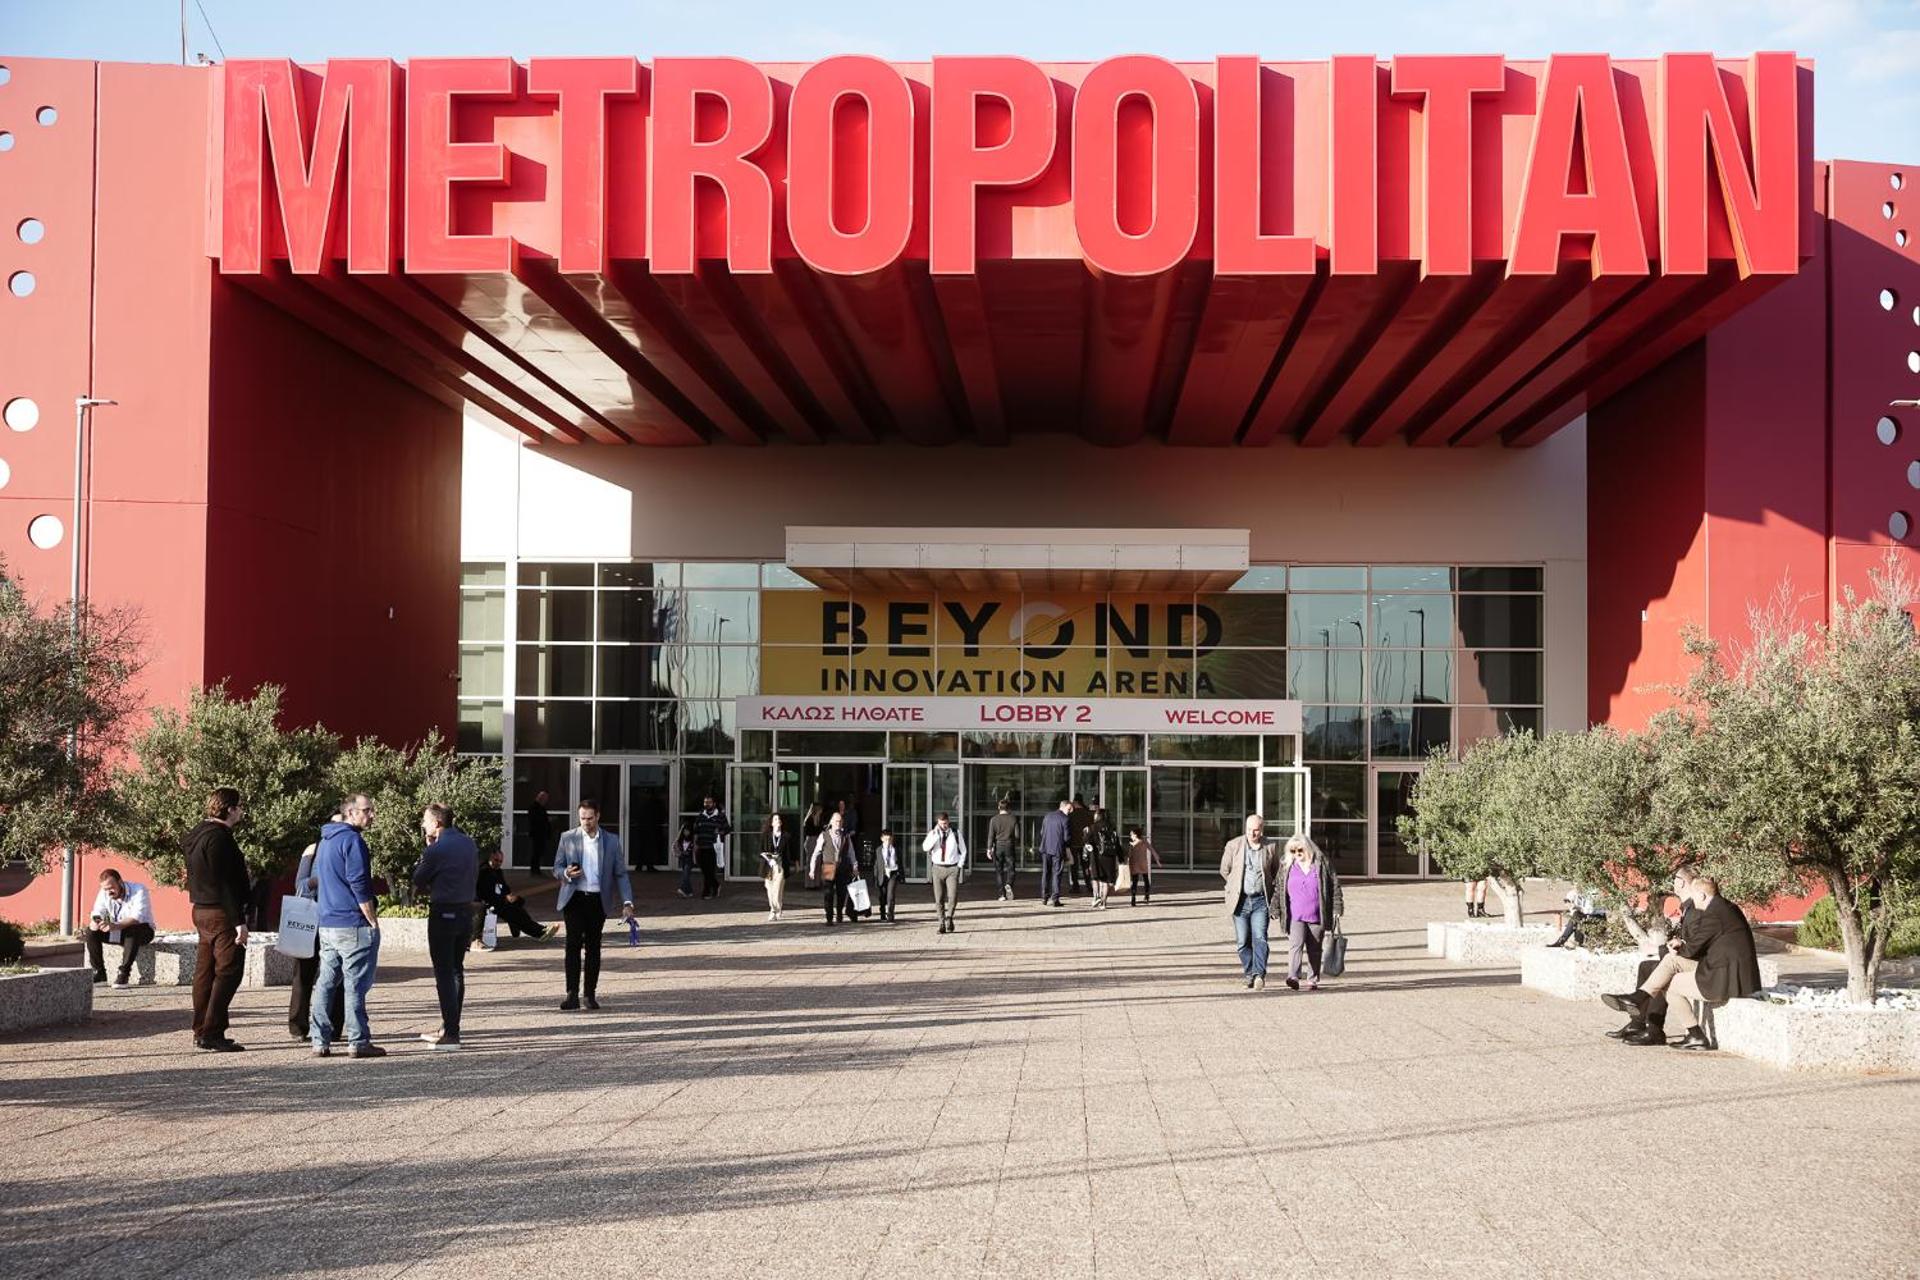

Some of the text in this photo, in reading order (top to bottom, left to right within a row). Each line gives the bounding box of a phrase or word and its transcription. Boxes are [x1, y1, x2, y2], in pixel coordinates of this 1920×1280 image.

[220, 51, 1799, 279] METROPOLITAN
[821, 601, 1223, 660] BEYOND
[821, 667, 1217, 695] INNOVATION ARENA
[762, 706, 925, 722] ΚΑΛΩΣ ΗΛΘΑΤΕ
[980, 705, 1092, 723] LOBBY 2
[1166, 710, 1275, 725] WELCOME
